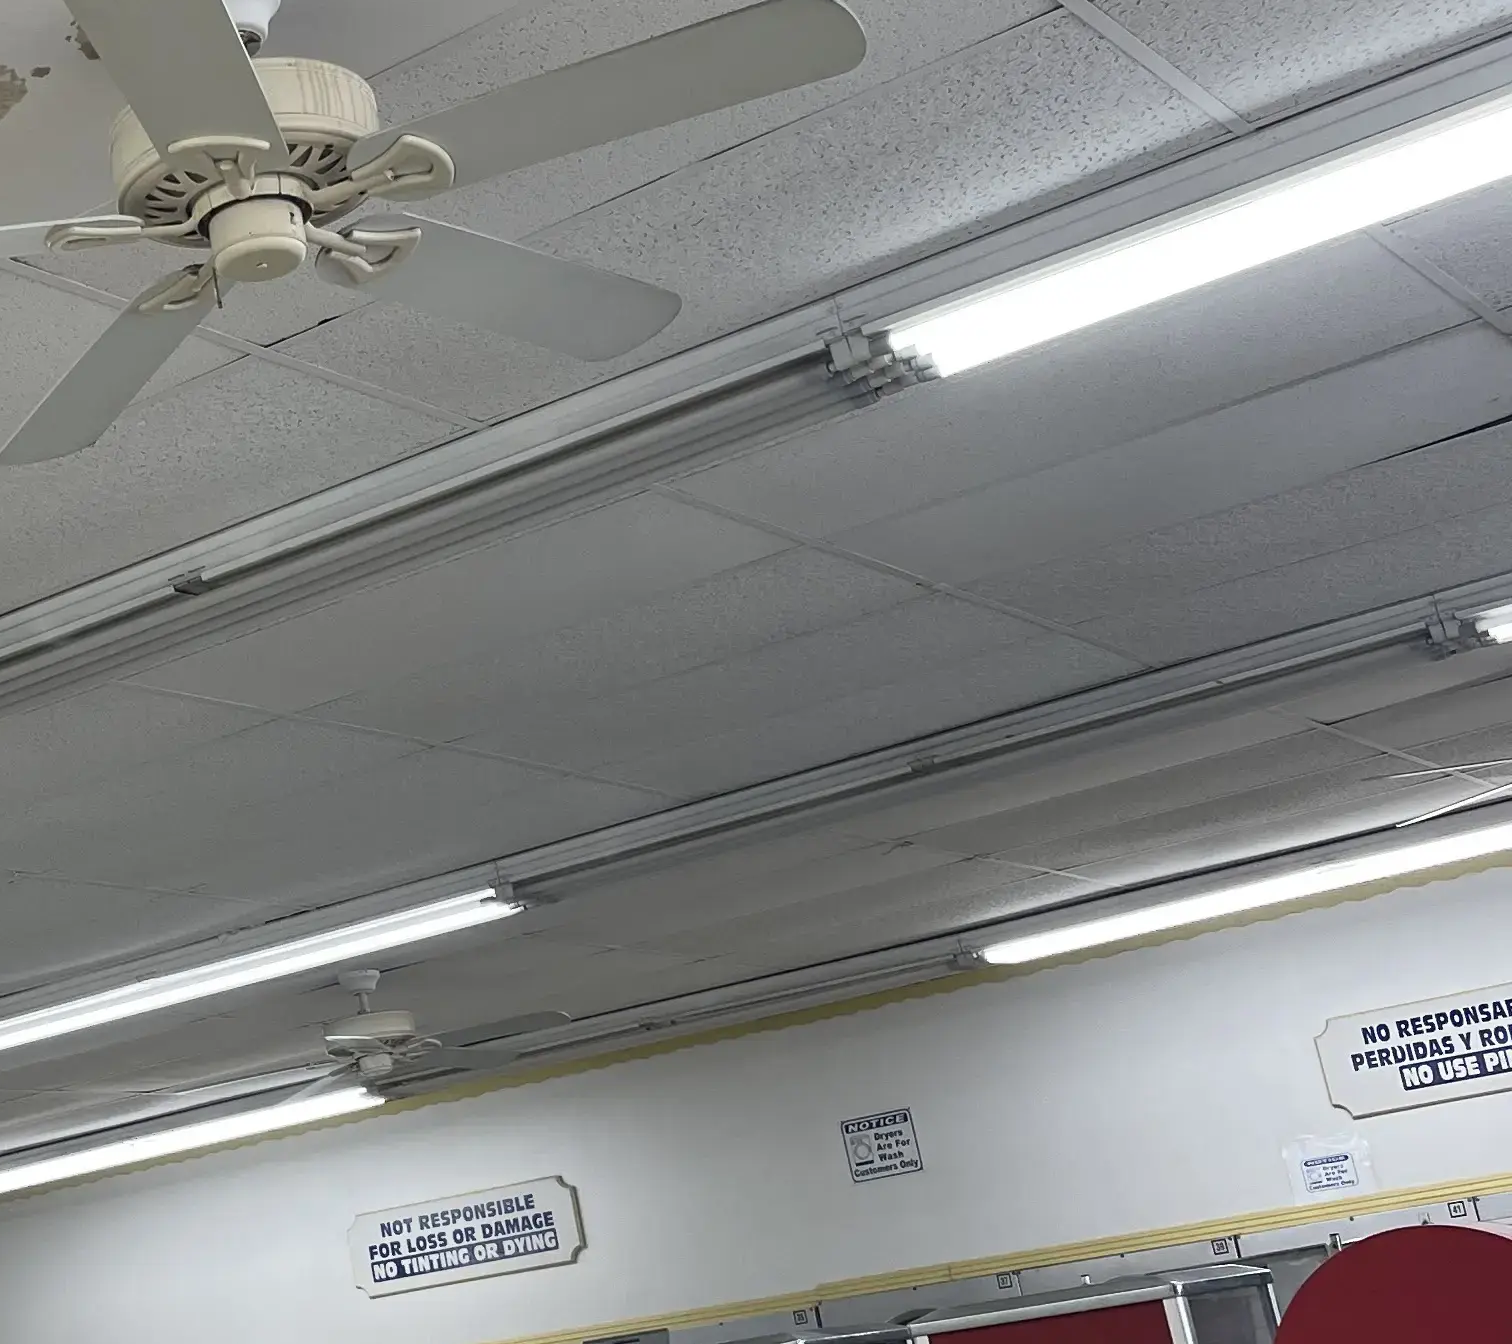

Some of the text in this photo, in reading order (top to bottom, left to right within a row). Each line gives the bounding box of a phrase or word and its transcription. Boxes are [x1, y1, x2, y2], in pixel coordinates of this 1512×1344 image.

[1361, 1023, 1391, 1045] NO
[1350, 1035, 1455, 1072] PERDIDAS
[1458, 1032, 1471, 1050] Y
[1402, 1064, 1433, 1088] NO
[1438, 1055, 1480, 1080] USE
[848, 1114, 906, 1133] NOTICE
[874, 1129, 903, 1141] Dryers
[877, 1139, 910, 1151] Are For
[878, 1151, 904, 1162] Wash
[854, 1159, 918, 1177] Customers Only
[380, 1193, 535, 1238] NOT RESPONSIBLE
[369, 1211, 555, 1261] FOR LOSS OR DAMAGE
[373, 1231, 557, 1280] NO TINTING OR DYING
